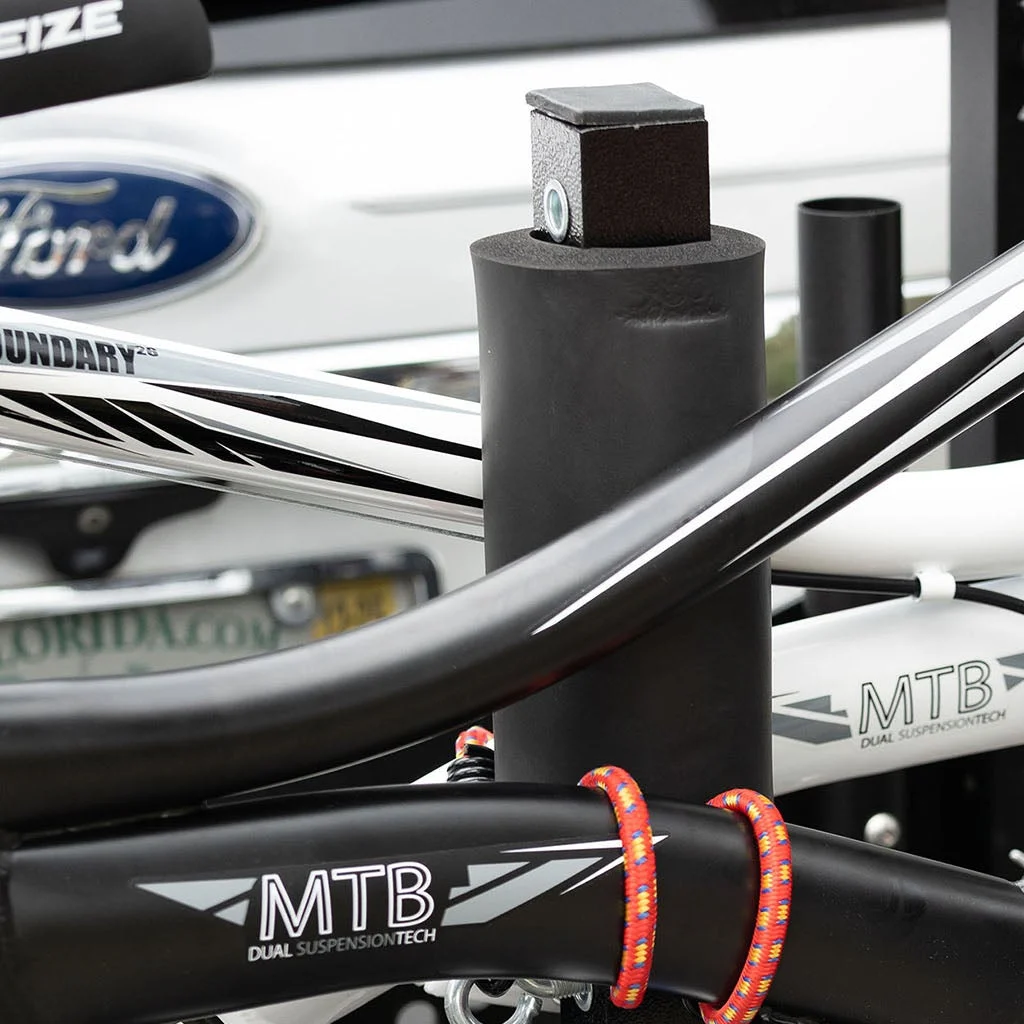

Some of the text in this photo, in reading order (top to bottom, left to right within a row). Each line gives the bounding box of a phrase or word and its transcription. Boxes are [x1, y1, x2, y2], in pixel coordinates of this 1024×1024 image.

[0, 328, 135, 375] UNDARY
[0, 605, 280, 664] ORIDA.COM
[859, 660, 993, 735] MTB
[860, 732, 895, 749] DUAL
[259, 861, 435, 941] MTB
[247, 943, 294, 962] DUAL
